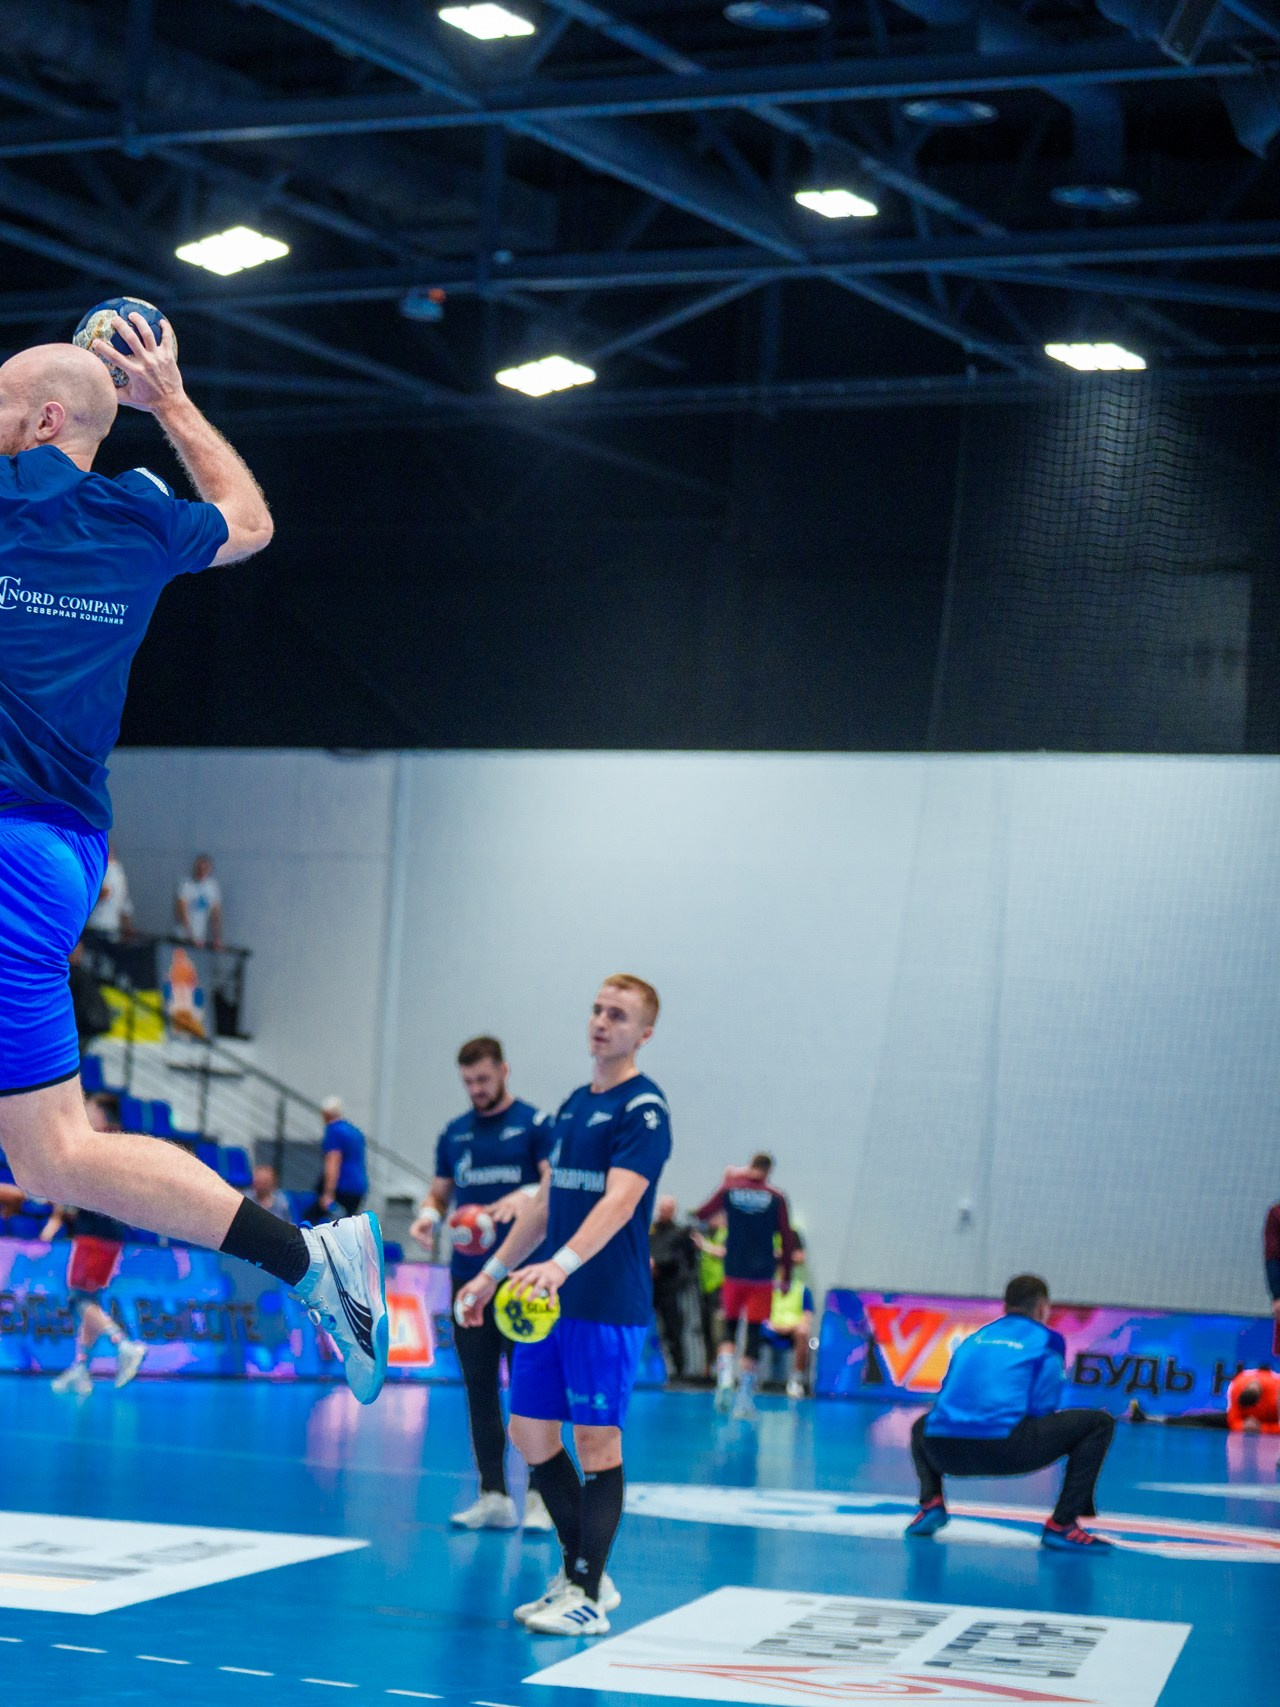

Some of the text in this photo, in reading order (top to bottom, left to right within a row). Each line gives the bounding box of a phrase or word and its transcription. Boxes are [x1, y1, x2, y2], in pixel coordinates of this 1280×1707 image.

[7, 588, 129, 617] NORD COMPANY
[26, 605, 124, 625] СЕВЕРНАЯ КОМПАНИЯ
[1073, 1353, 1194, 1396] БУДЬ
